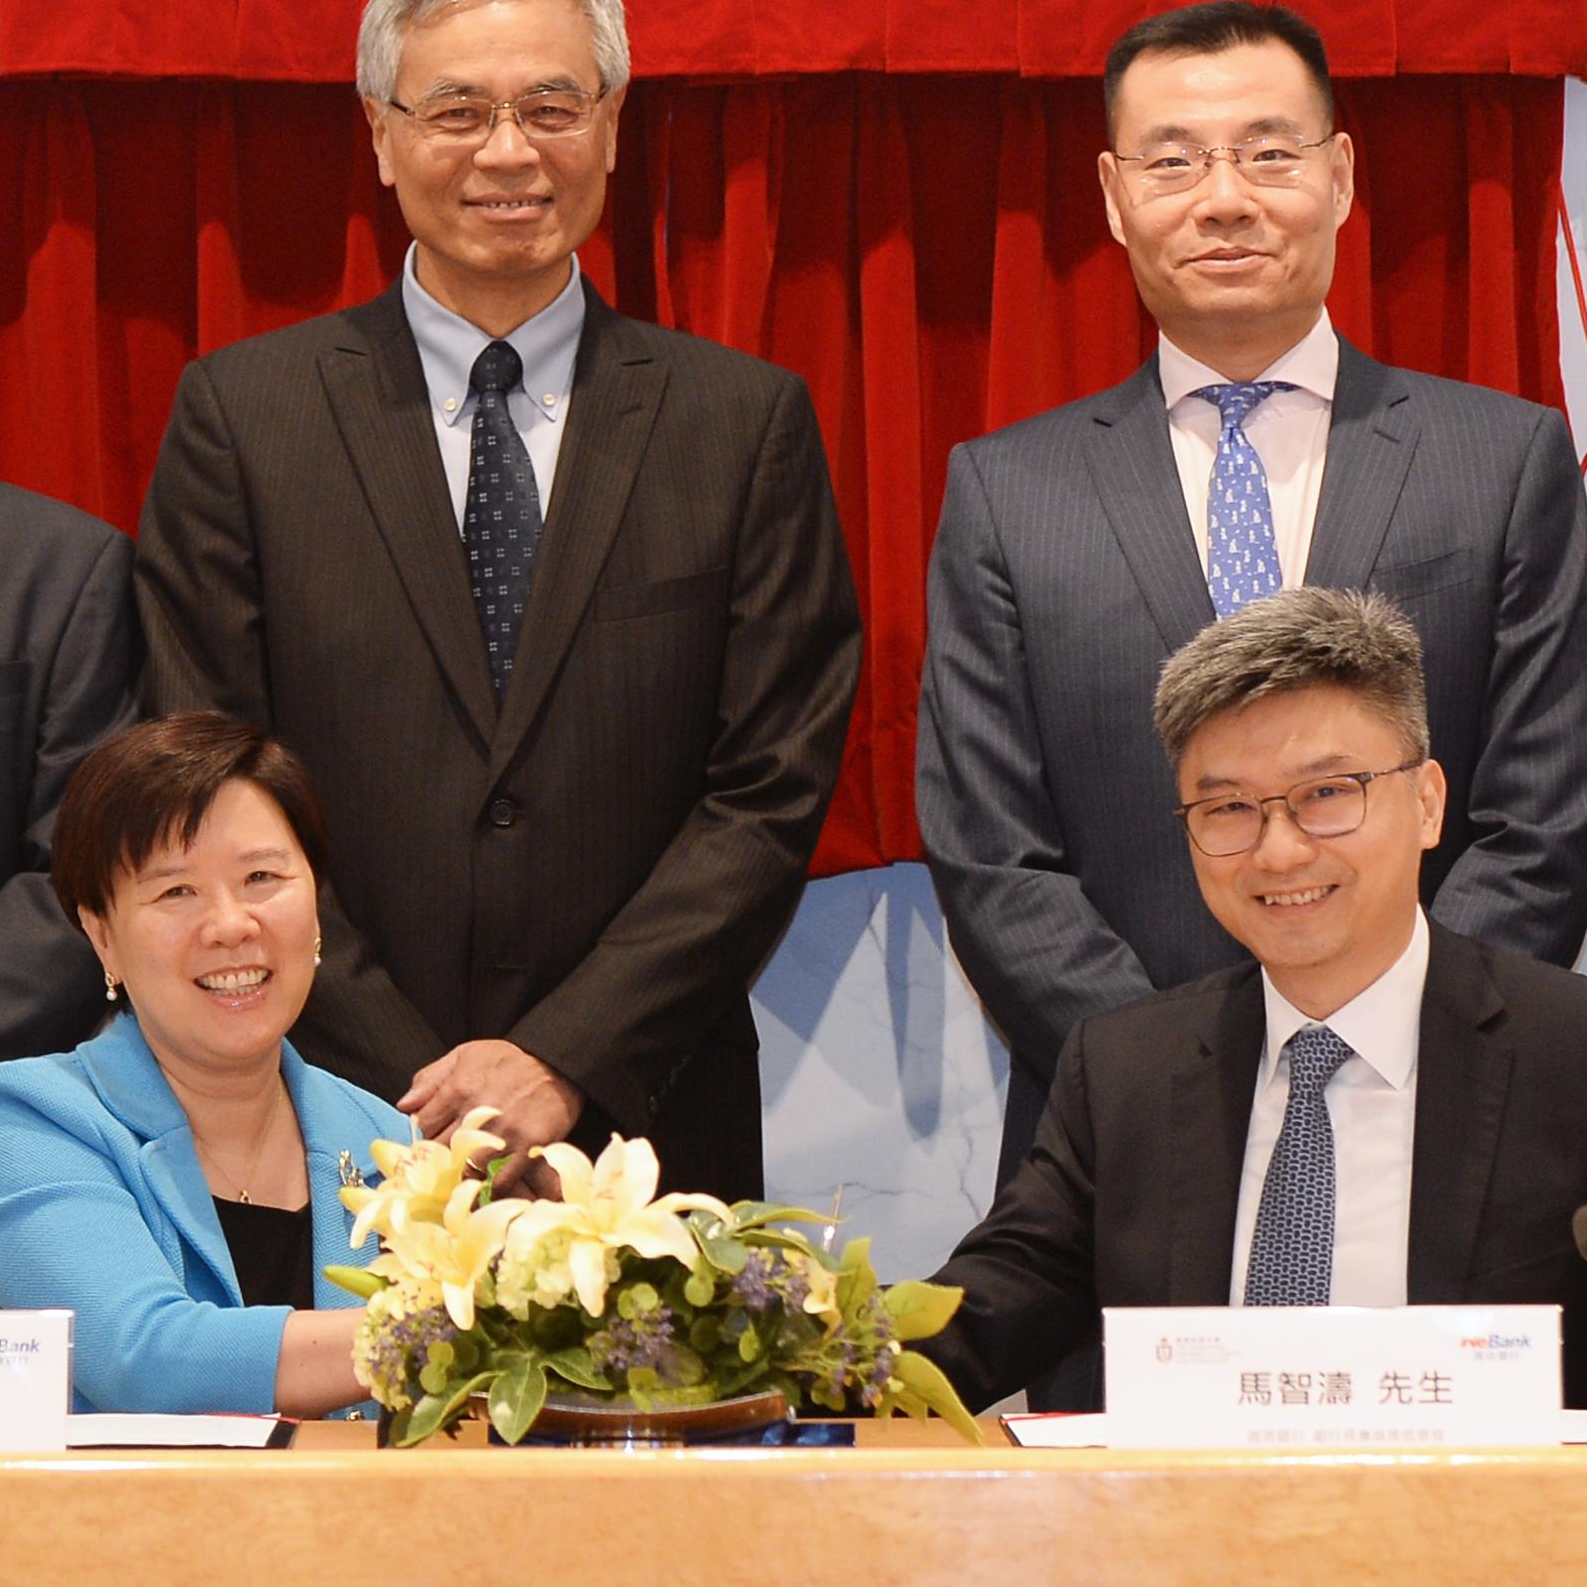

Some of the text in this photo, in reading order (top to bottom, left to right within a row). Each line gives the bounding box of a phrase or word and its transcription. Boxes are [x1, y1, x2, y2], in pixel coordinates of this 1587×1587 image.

[1238, 1371, 1453, 1406] 馬智濤 先生
